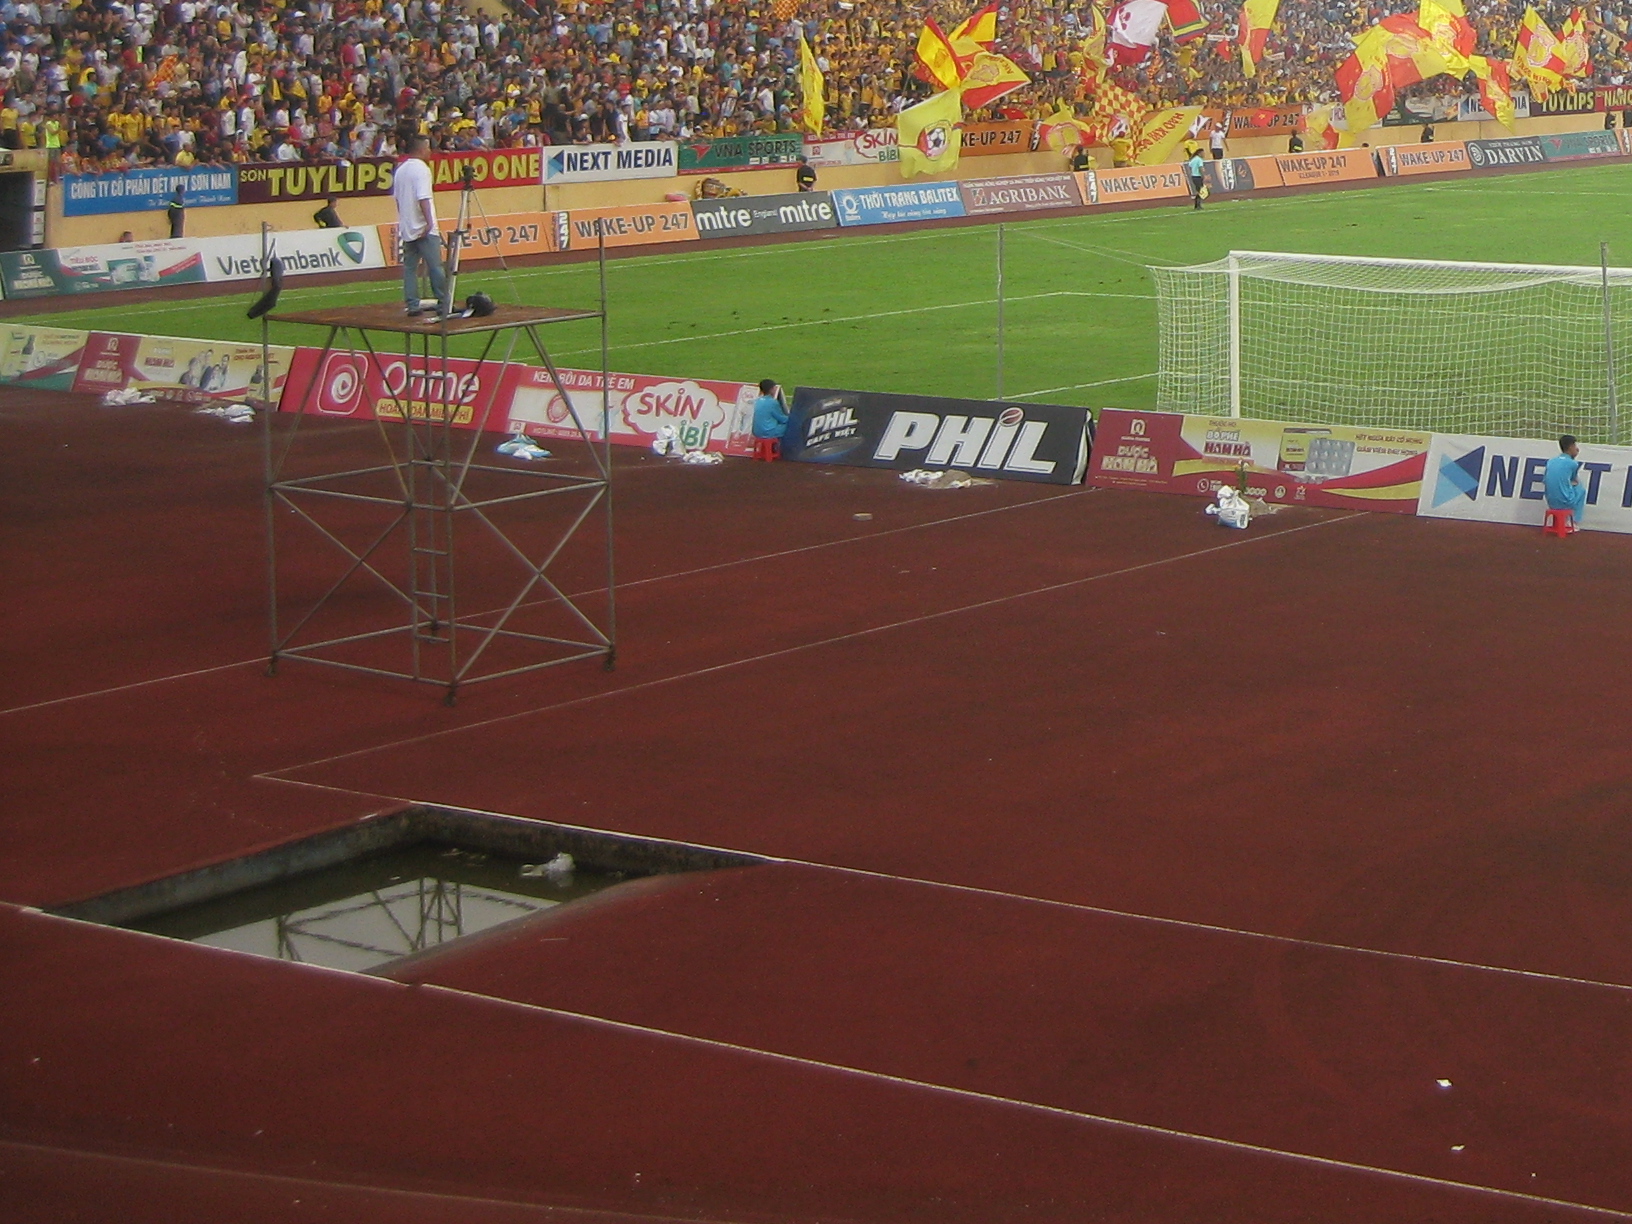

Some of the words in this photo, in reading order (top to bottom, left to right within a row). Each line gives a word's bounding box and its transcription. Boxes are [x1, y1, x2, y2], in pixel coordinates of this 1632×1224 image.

[1542, 91, 1595, 112] TUYLIPS
[1283, 113, 1299, 126] 247
[1000, 130, 1022, 144] 247
[715, 143, 743, 158] VNA
[749, 139, 797, 156] SPORTS
[1399, 152, 1446, 166] WAKE-UP
[1447, 150, 1464, 162] 247
[1485, 145, 1544, 165] DARVIN
[492, 154, 540, 180] ONE
[566, 149, 611, 172] NEXT
[615, 147, 673, 170] MEDIA
[1280, 157, 1327, 173] WAKE-UP
[1330, 155, 1347, 168] 247
[71, 178, 96, 199] CÔNG
[98, 181, 109, 197] TY
[211, 173, 231, 190] NAM
[267, 163, 394, 197] TUYLIPS
[1101, 176, 1158, 193] WAKE-UP
[1160, 174, 1182, 188] 247
[886, 190, 919, 207] TRANG
[919, 187, 960, 205] BALITEX
[990, 185, 1071, 205] AGRIBANK
[697, 206, 752, 231] mitre
[780, 199, 833, 224] mitre
[507, 225, 538, 244] 247
[575, 215, 655, 239] WAKE-UP
[662, 212, 688, 231] 247
[217, 247, 342, 276] Vietmbank
[382, 361, 480, 404] Onme
[578, 375, 592, 387] DA
[617, 378, 635, 390] EM
[678, 419, 708, 448] IBI
[1485, 455, 1612, 505] NET
